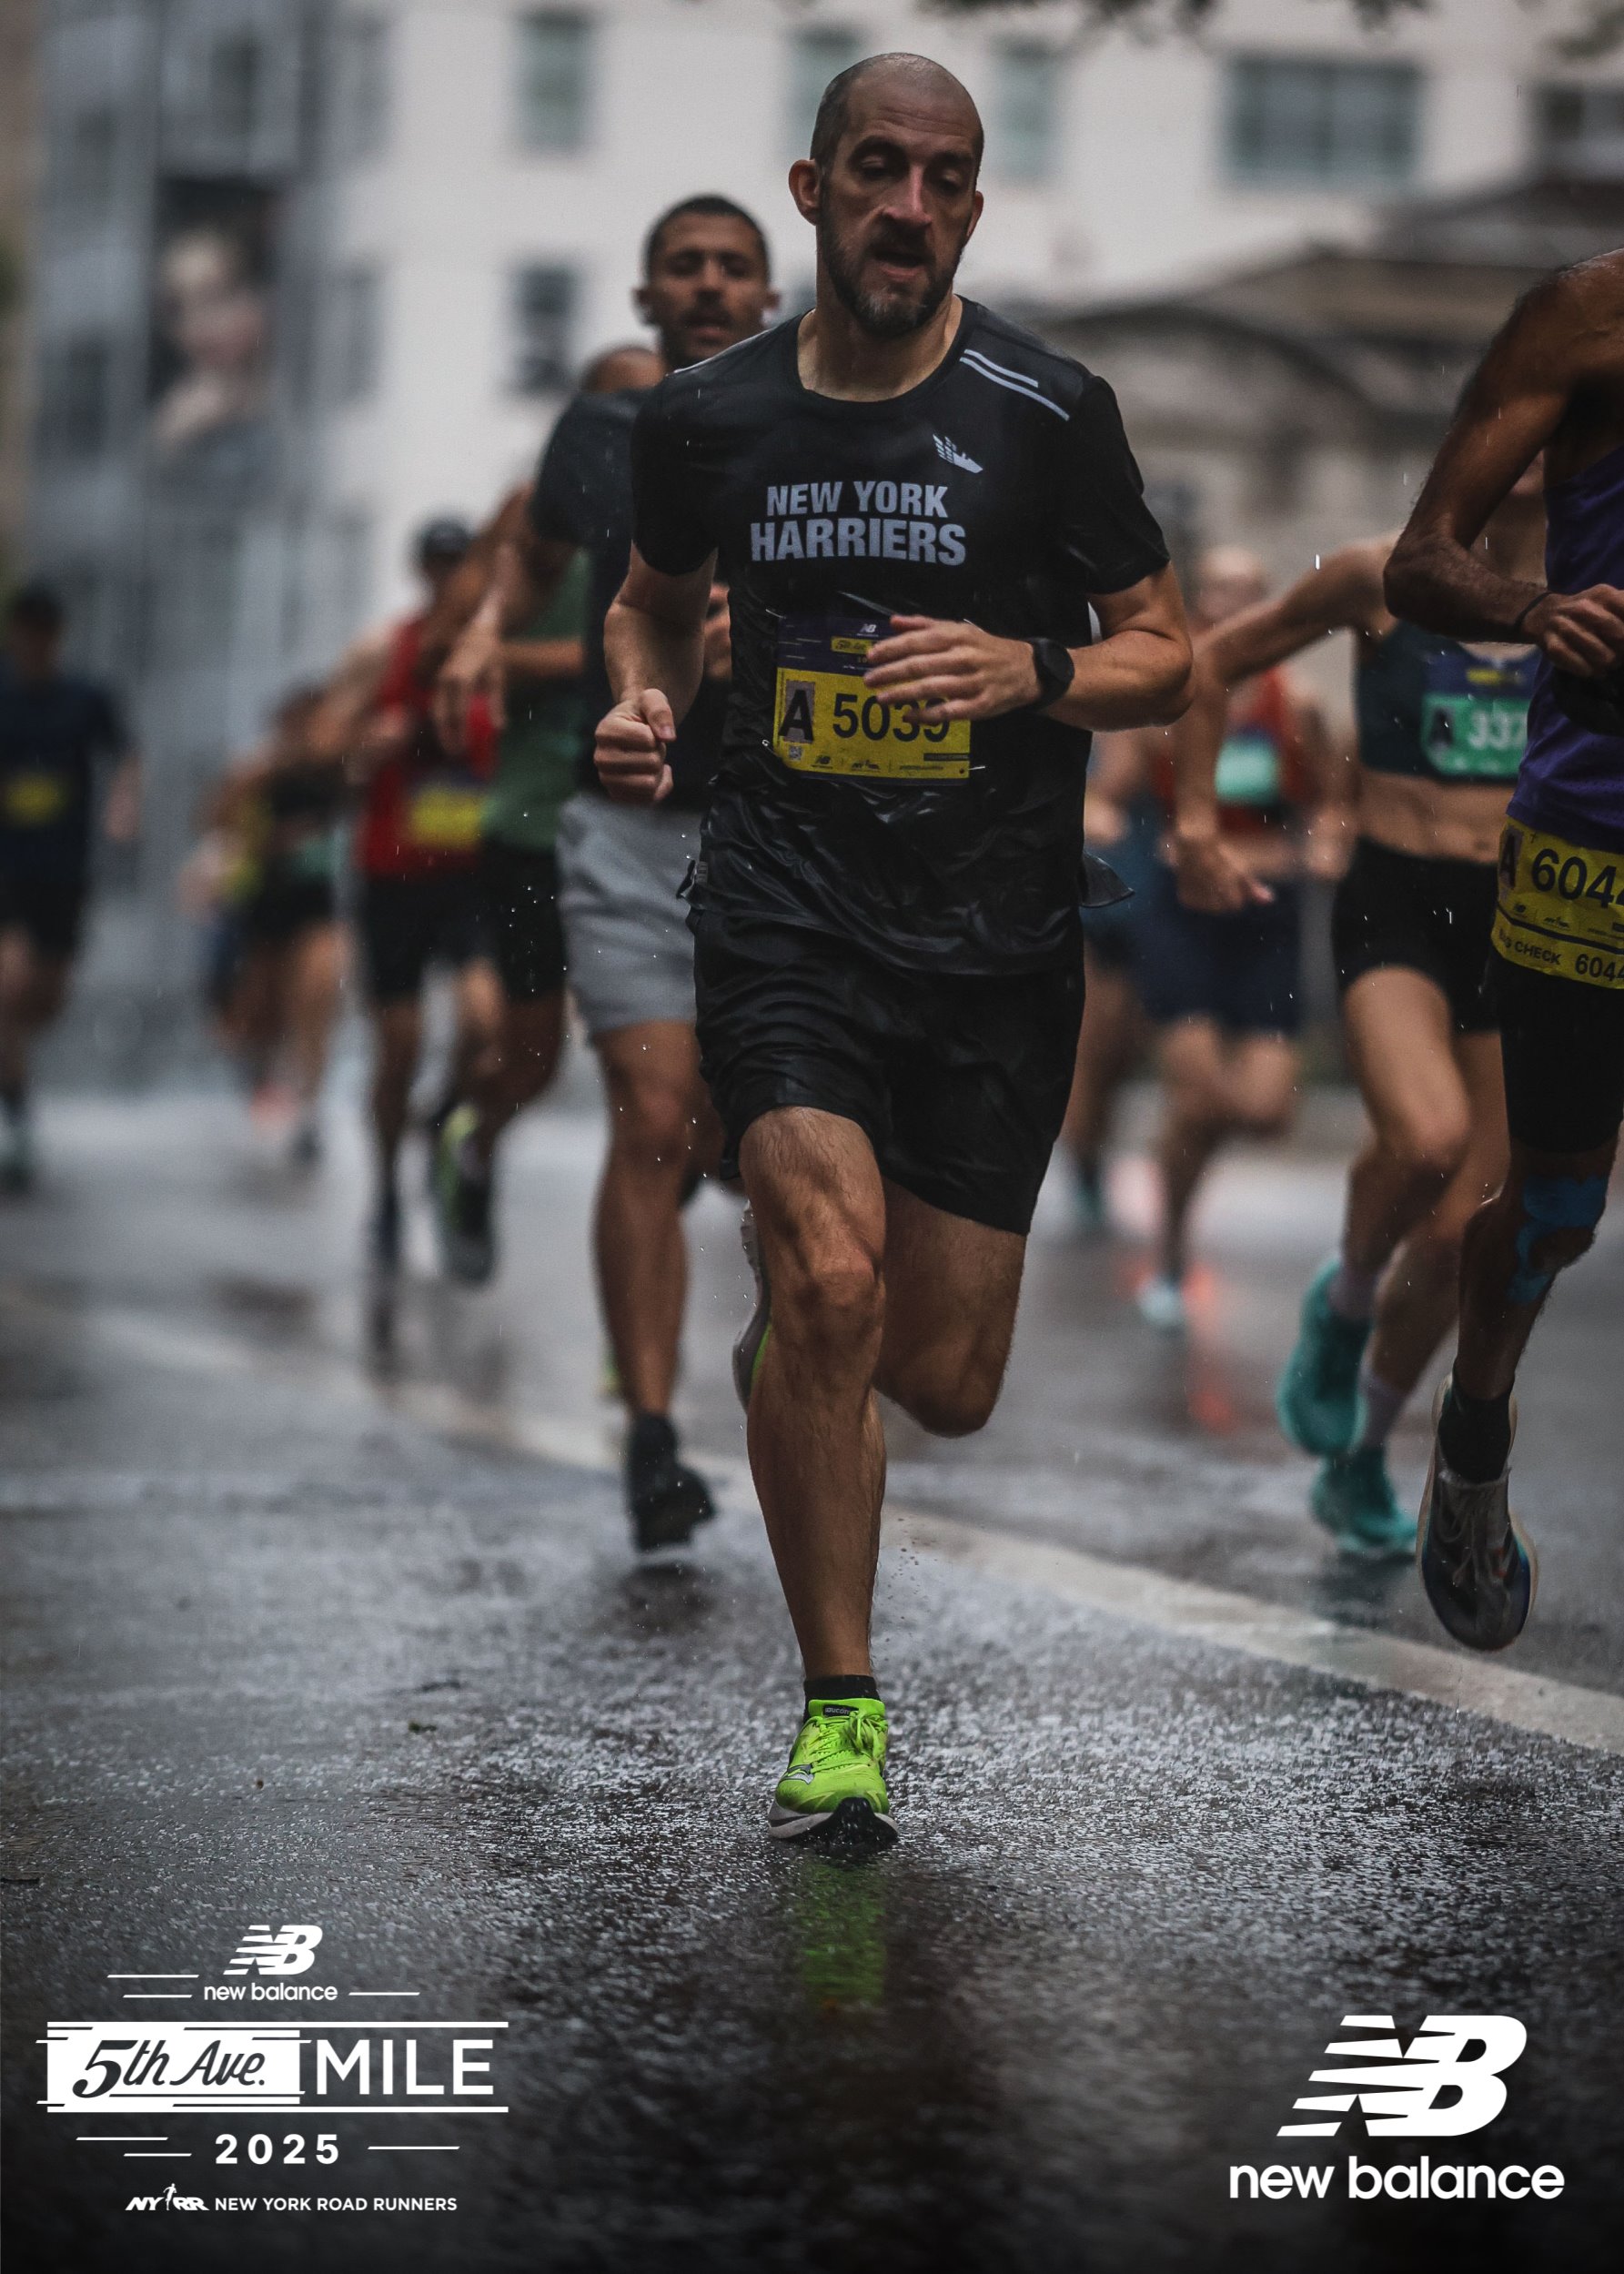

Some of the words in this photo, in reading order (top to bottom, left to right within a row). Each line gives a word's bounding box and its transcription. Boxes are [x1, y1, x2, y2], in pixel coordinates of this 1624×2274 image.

[767, 481, 842, 517] NEW
[853, 480, 948, 518] YORK
[751, 518, 966, 566] HARRIERS
[778, 689, 814, 742] A
[832, 692, 951, 743] 5039
[1514, 940, 1562, 965] CHECK
